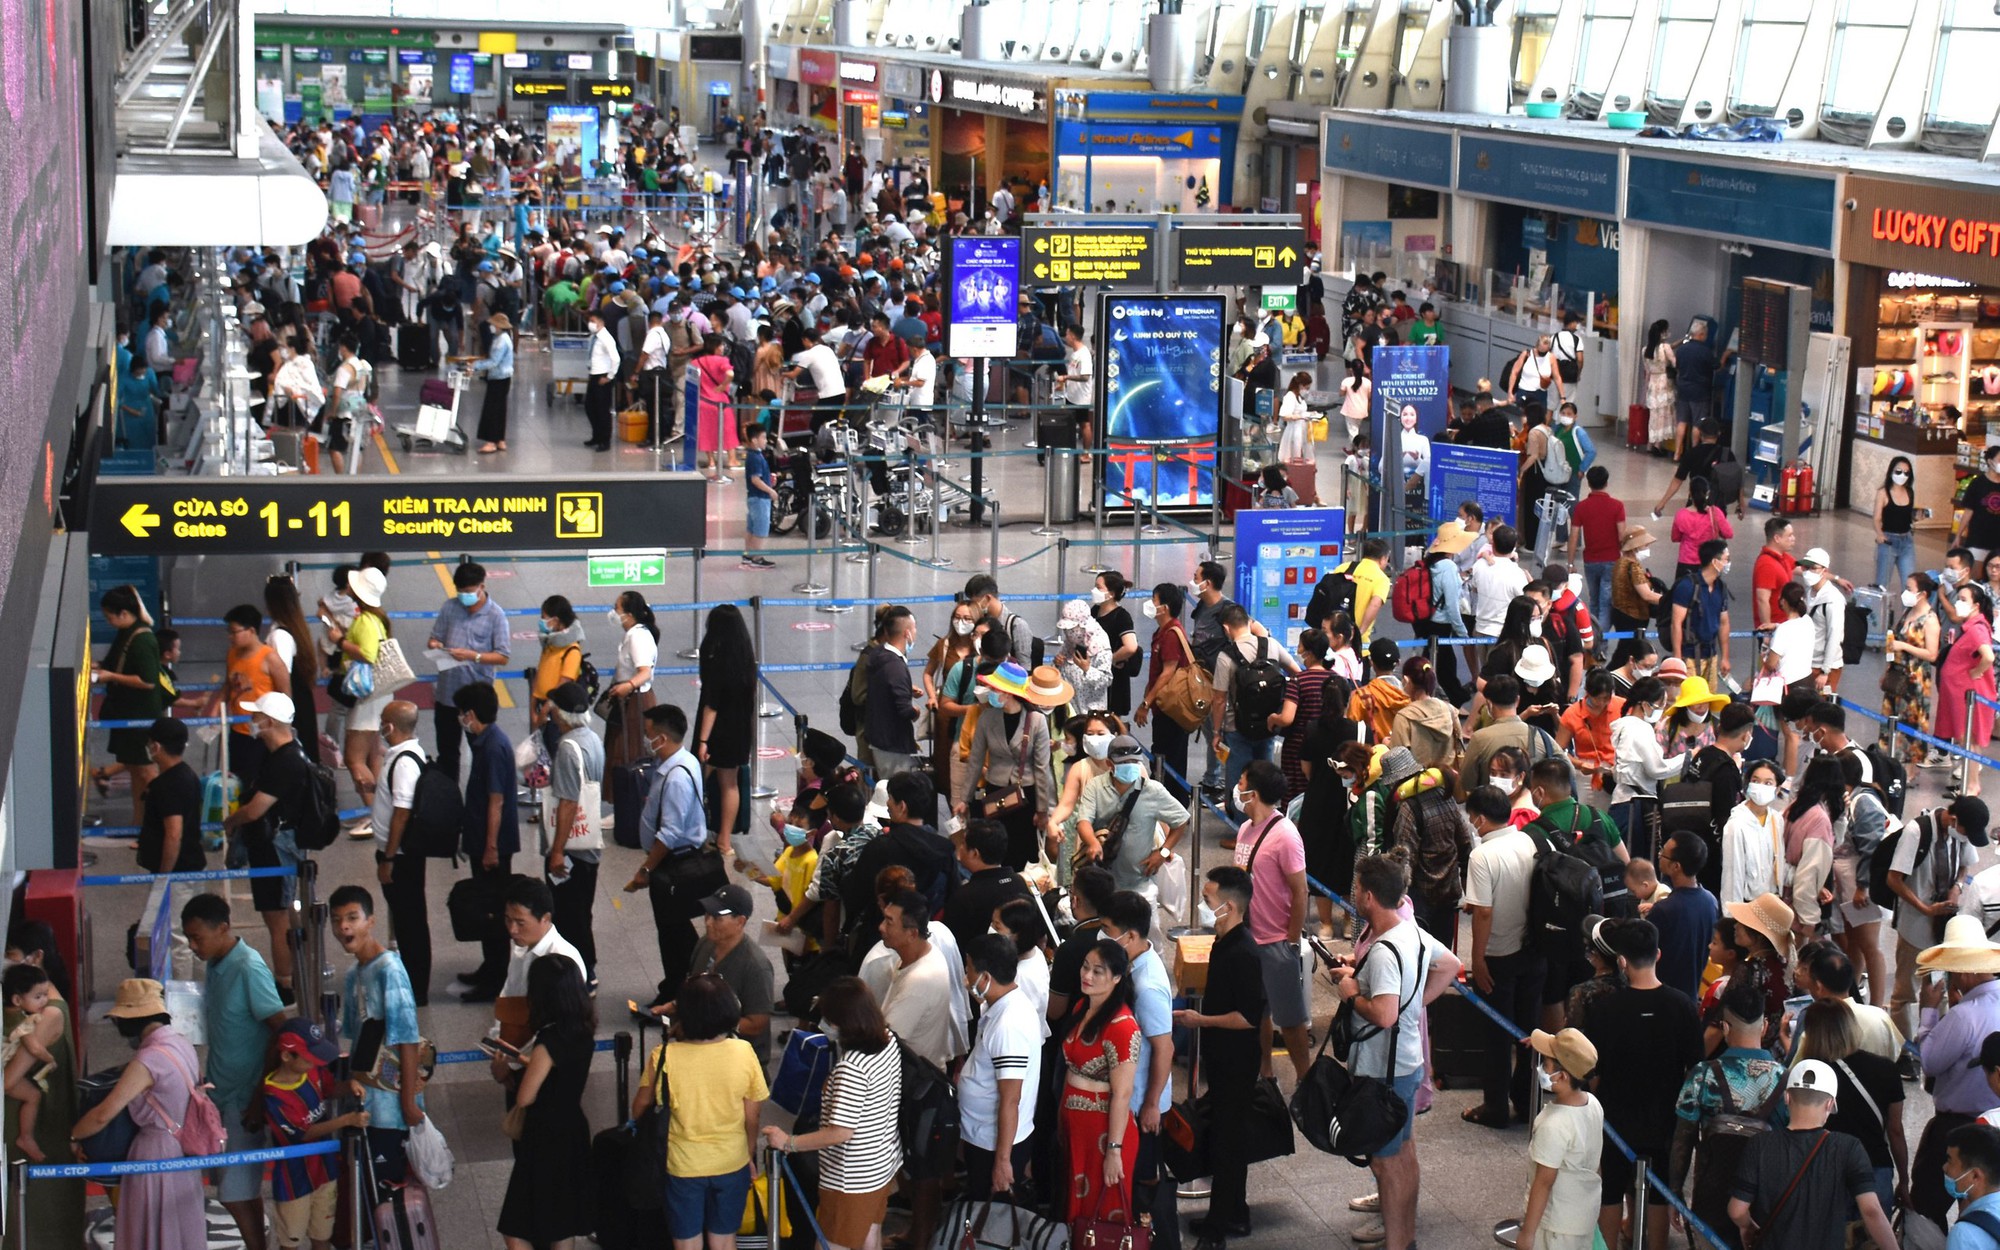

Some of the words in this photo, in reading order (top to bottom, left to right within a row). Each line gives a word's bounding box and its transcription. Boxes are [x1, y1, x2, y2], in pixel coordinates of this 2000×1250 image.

[1872, 207, 1948, 249] LUCKY
[1268, 295, 1283, 307] EXIT
[1151, 308, 1164, 317] Fuji
[1397, 387, 1416, 396] NAM
[1418, 387, 1438, 395] 2022
[173, 497, 218, 517] CỬA
[433, 498, 470, 513] TRA
[470, 498, 499, 513] AN
[503, 497, 547, 513] NINH
[259, 501, 279, 537] 1
[288, 518, 303, 529] -
[308, 501, 350, 537] 11
[383, 518, 455, 537] Security
[459, 518, 513, 534] Check
[173, 521, 227, 538] Gates
[111, 1162, 158, 1174] AIRPORTS
[159, 1156, 227, 1171] CORPORATION
[227, 1154, 241, 1163] OF
[242, 1149, 285, 1162] VIETNAM
[33, 1167, 56, 1178] NAM
[64, 1166, 90, 1177] CTCP
